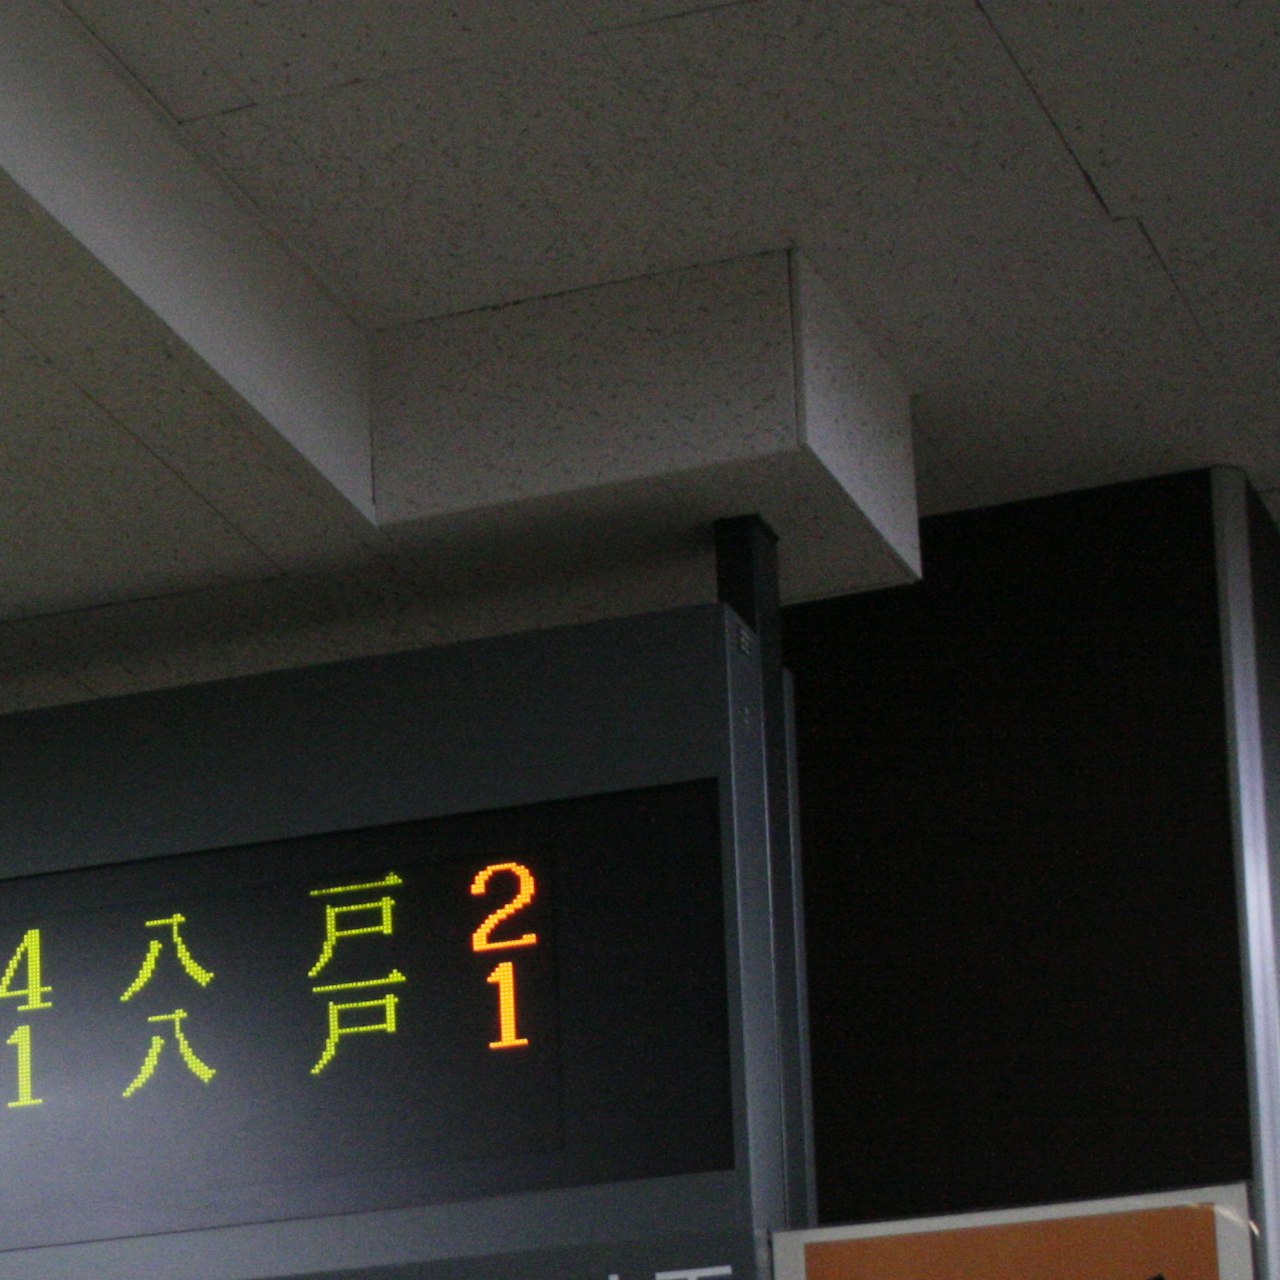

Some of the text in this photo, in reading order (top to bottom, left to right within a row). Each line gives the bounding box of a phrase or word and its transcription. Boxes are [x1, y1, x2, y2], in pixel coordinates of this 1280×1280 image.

[121, 872, 402, 1002] 八戸
[469, 861, 536, 952] 2
[122, 969, 406, 1098] 八戸
[486, 961, 529, 1050] 1
